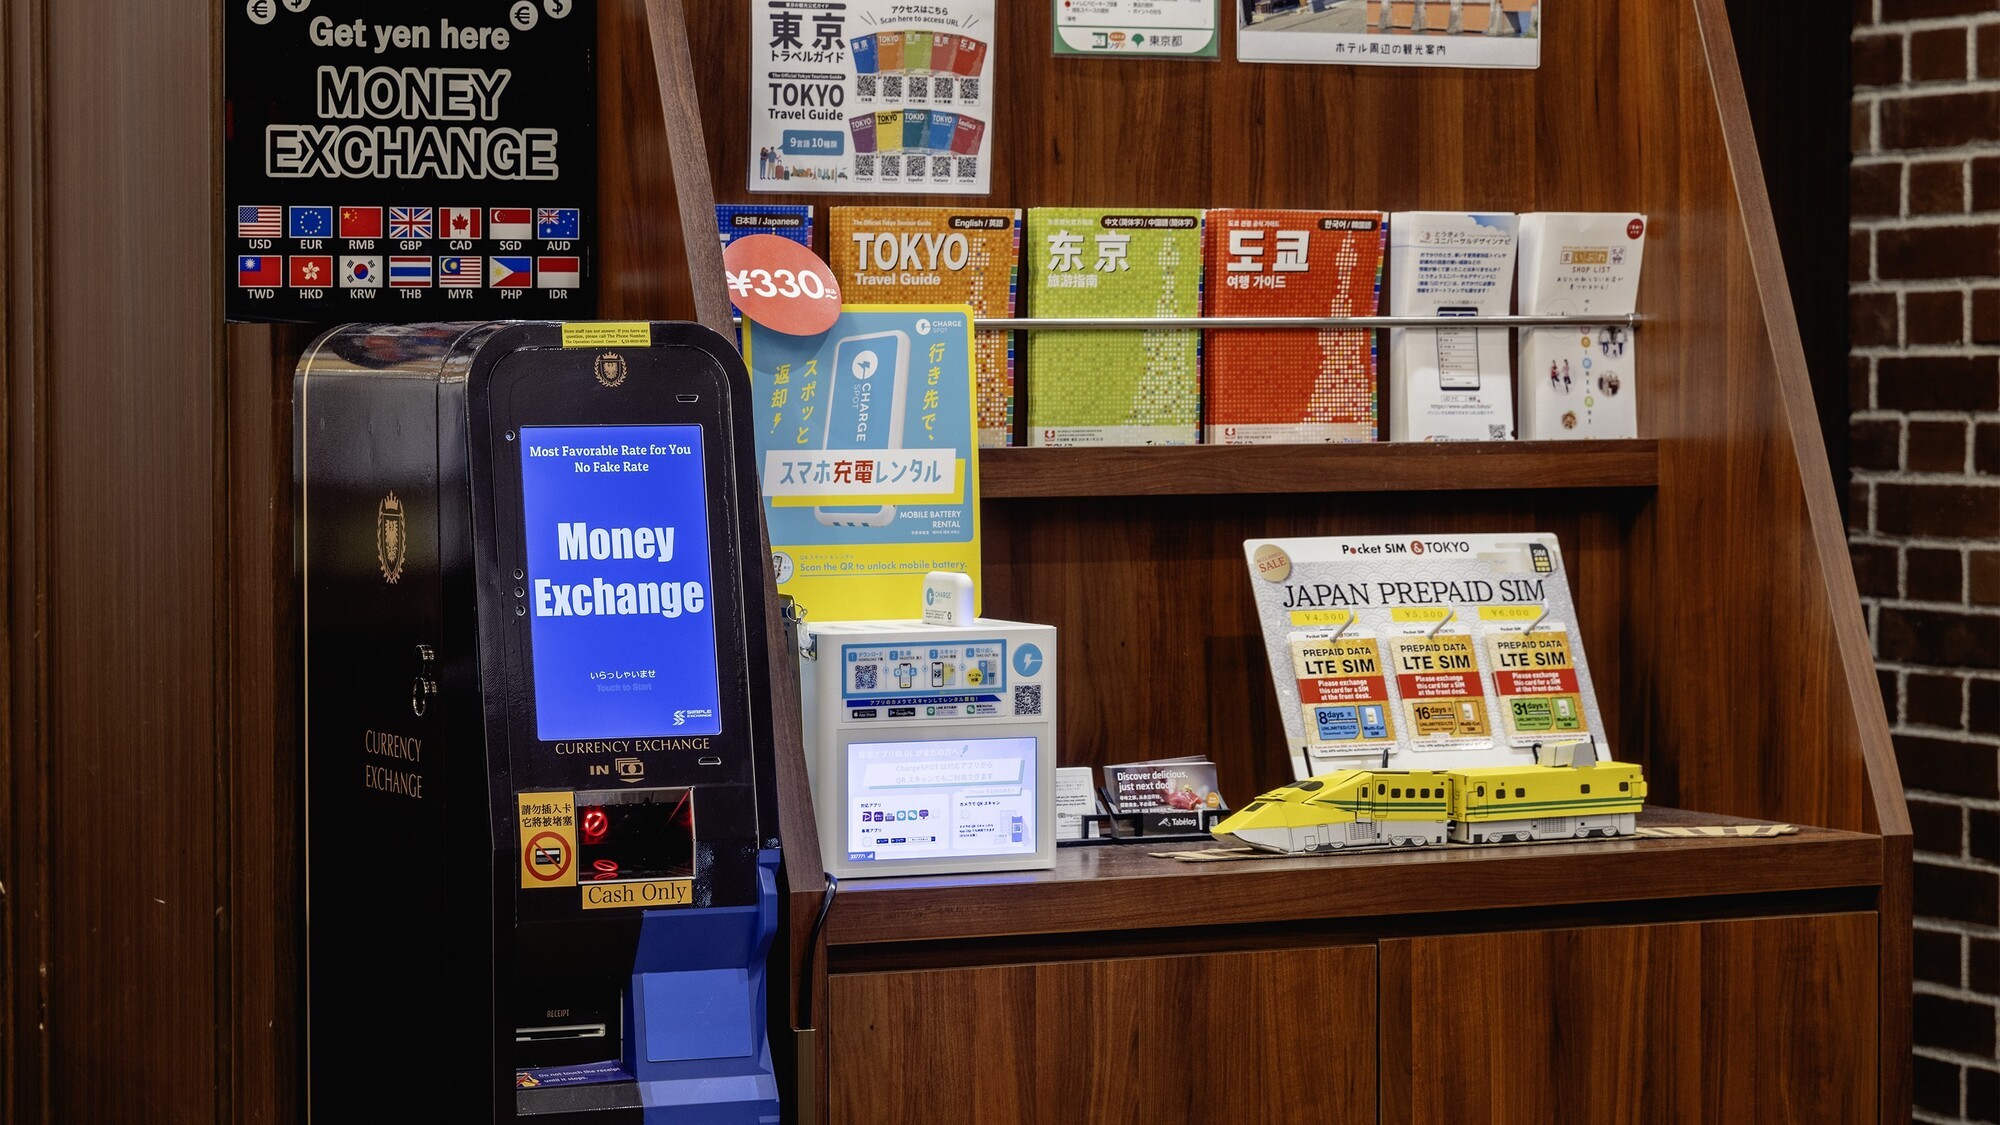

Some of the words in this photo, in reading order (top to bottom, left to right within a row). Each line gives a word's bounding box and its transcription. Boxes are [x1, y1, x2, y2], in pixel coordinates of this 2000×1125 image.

[891, 5, 949, 16] アクセスはこちら
[946, 19, 960, 27] URL
[310, 15, 367, 48] Get
[374, 25, 430, 53] yen
[441, 18, 510, 50] here
[769, 11, 846, 50] 東京
[1149, 35, 1183, 47] 東京都
[1335, 42, 1446, 56] ホテル周辺の観光案内
[771, 50, 844, 63] トラベルガイド
[317, 65, 511, 121] MONEY
[769, 83, 845, 107] TOKYO
[768, 108, 805, 120] Travel
[808, 109, 844, 120] Guide
[904, 112, 925, 121] TOKIO
[265, 124, 558, 181] EXCHANGE
[735, 216, 758, 226] 日本語
[762, 217, 800, 227] Japanese
[954, 218, 983, 229] English
[1324, 220, 1346, 230] 한국어
[248, 239, 272, 250] USD
[300, 240, 323, 250] EUR
[349, 240, 375, 250] RMB
[399, 240, 423, 251] GBP
[449, 240, 473, 251] CAD
[499, 240, 522, 251] SGD
[547, 240, 571, 251] AUD
[1047, 229, 1132, 273] 东京
[1226, 230, 1310, 272] 도쿄
[852, 232, 969, 272] TOKYO
[854, 273, 896, 286] Travel
[900, 273, 941, 286] Guide
[1047, 273, 1099, 288] 旅游指南
[1226, 275, 1250, 289] 여행
[1253, 275, 1287, 289] 가이드
[247, 288, 275, 299] TWD
[299, 288, 324, 299] HKD
[350, 288, 377, 299] KRW
[399, 288, 423, 299] THB
[448, 288, 473, 299] MYR
[500, 289, 523, 300] PHP
[548, 289, 568, 299] IDR
[932, 320, 962, 328] CHARGE
[796, 359, 818, 445] スポッと
[852, 384, 861, 409] SPOT
[856, 382, 871, 442] CHARGE
[529, 446, 559, 457] Most
[562, 445, 618, 457] Favorable
[621, 445, 647, 456] Rate
[650, 444, 667, 455] for
[669, 444, 691, 455] You
[574, 462, 591, 473] No
[593, 461, 620, 473] Fake
[623, 461, 649, 472] Rate
[779, 460, 941, 485] スマホ充電レンタル
[900, 511, 928, 519] MOBILE
[929, 510, 962, 519] BATTERY
[932, 520, 961, 528] RENTAL
[557, 522, 675, 563] Money
[1342, 543, 1382, 554] Pocket
[1385, 543, 1407, 554] SIM
[1424, 541, 1470, 553] TOKYO
[1533, 548, 1547, 556] SIM
[800, 563, 822, 572] Scan
[824, 562, 838, 570] the
[840, 562, 854, 571] QR
[855, 562, 865, 570] to
[867, 561, 896, 570] unlock
[899, 560, 930, 569] mobile
[932, 560, 967, 570] battery.
[1258, 556, 1287, 573] SALE
[534, 577, 705, 618] Exchange
[1283, 583, 1372, 608] JAPAN
[1377, 580, 1493, 604] PREPAID
[1499, 579, 1546, 601] SIM
[1400, 644, 1440, 652] PREPAID
[1443, 643, 1467, 652] DATA
[1497, 641, 1537, 649] PREPAID
[1539, 640, 1563, 648] DATA
[1302, 648, 1344, 657] PREPAID
[1347, 647, 1371, 656] DATA
[1403, 656, 1434, 670] LTE
[1438, 655, 1470, 669] SIM
[1500, 653, 1530, 667] LTE
[1535, 651, 1566, 665] SIM
[1305, 660, 1337, 675] LTE
[1342, 658, 1375, 673] SIM
[590, 669, 656, 680] いらっしゃいませ
[596, 684, 621, 693] Touch
[622, 683, 631, 691] to
[633, 683, 652, 691] Start
[1415, 706, 1431, 720] 16
[1430, 706, 1446, 715] days
[1514, 702, 1528, 715] 31
[1528, 702, 1543, 710] days
[1318, 711, 1329, 724] 8
[1327, 711, 1344, 720] days
[365, 729, 422, 763] CURRENCY
[555, 741, 630, 755] CURRENCY
[635, 738, 710, 752] EXCHANGE
[590, 765, 609, 775] IN
[1117, 772, 1151, 781] Discover
[366, 764, 422, 799] EXCHANGE
[1119, 782, 1135, 793] just
[1136, 781, 1154, 790] next
[521, 803, 572, 815] 請勿插入卡
[522, 815, 573, 828] 它將被堵塞
[588, 886, 634, 904] Cash
[642, 883, 687, 903] Only
[546, 1009, 570, 1018] RECEIPT
